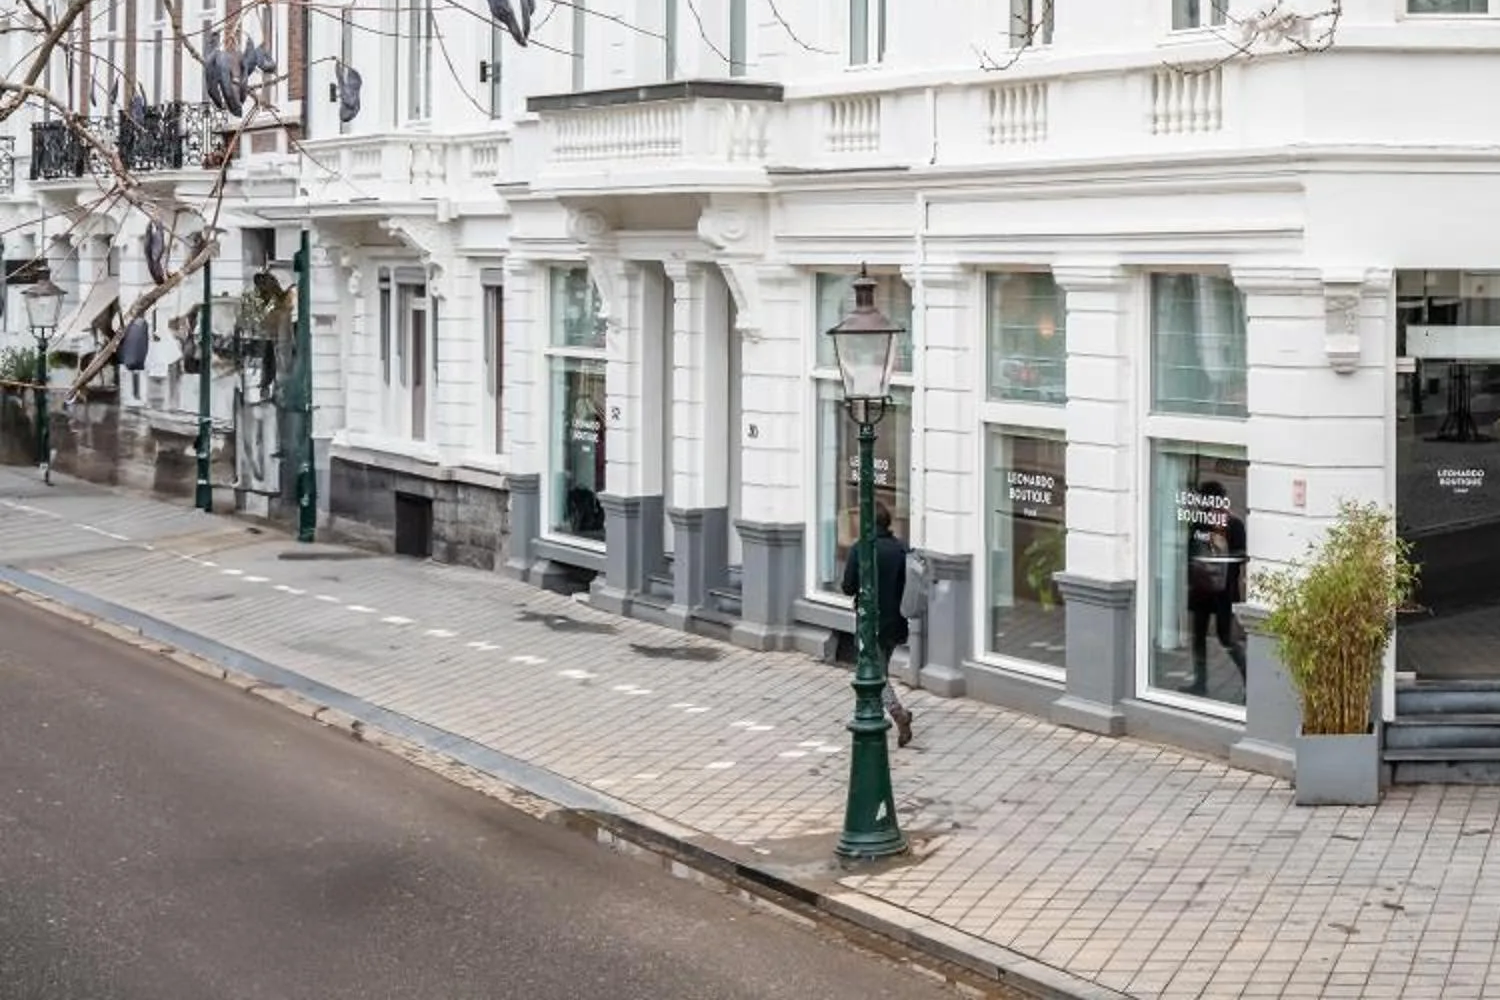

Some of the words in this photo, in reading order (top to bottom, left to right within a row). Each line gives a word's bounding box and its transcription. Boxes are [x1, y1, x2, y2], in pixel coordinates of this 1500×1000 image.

[1007, 471, 1055, 489] LEONARDO
[1009, 487, 1053, 505] BOUTIQUE
[1175, 491, 1231, 509] LEONARDO
[1177, 508, 1228, 527] BOUTIQUE
